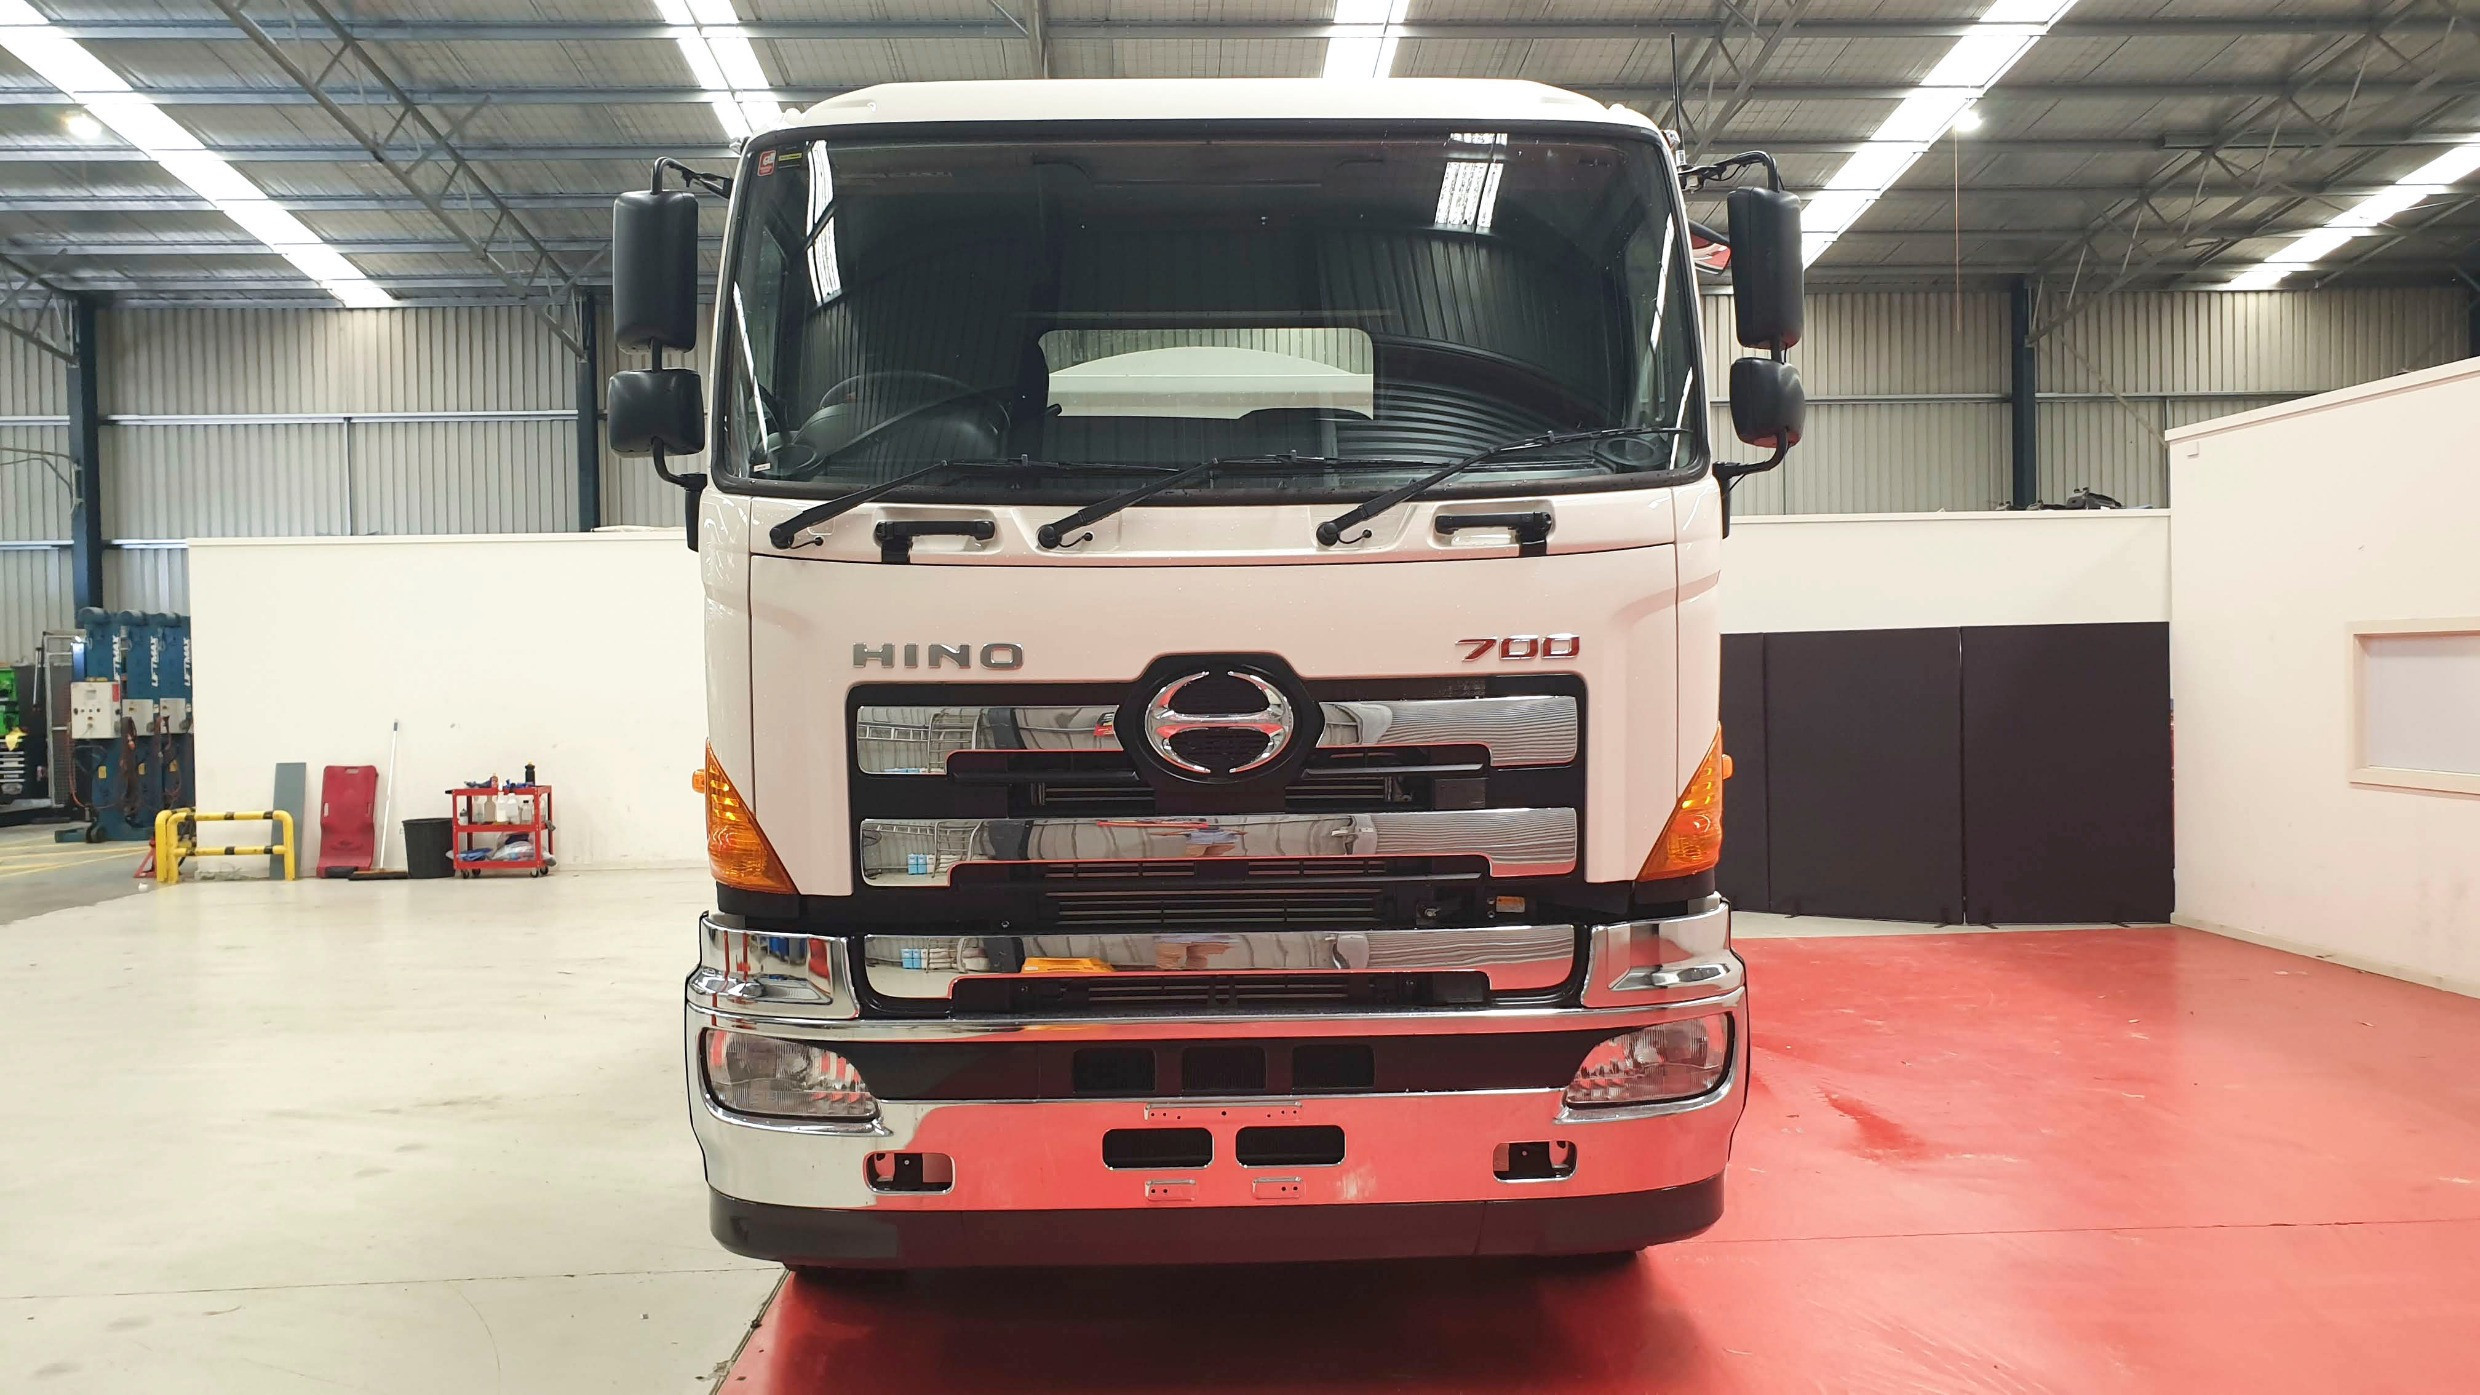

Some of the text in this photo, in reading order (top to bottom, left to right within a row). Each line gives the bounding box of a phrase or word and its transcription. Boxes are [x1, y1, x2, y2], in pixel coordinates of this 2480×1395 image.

[150, 635, 159, 687] LIFTMAX
[853, 643, 1024, 670] HINO
[1455, 633, 1580, 662] 700
